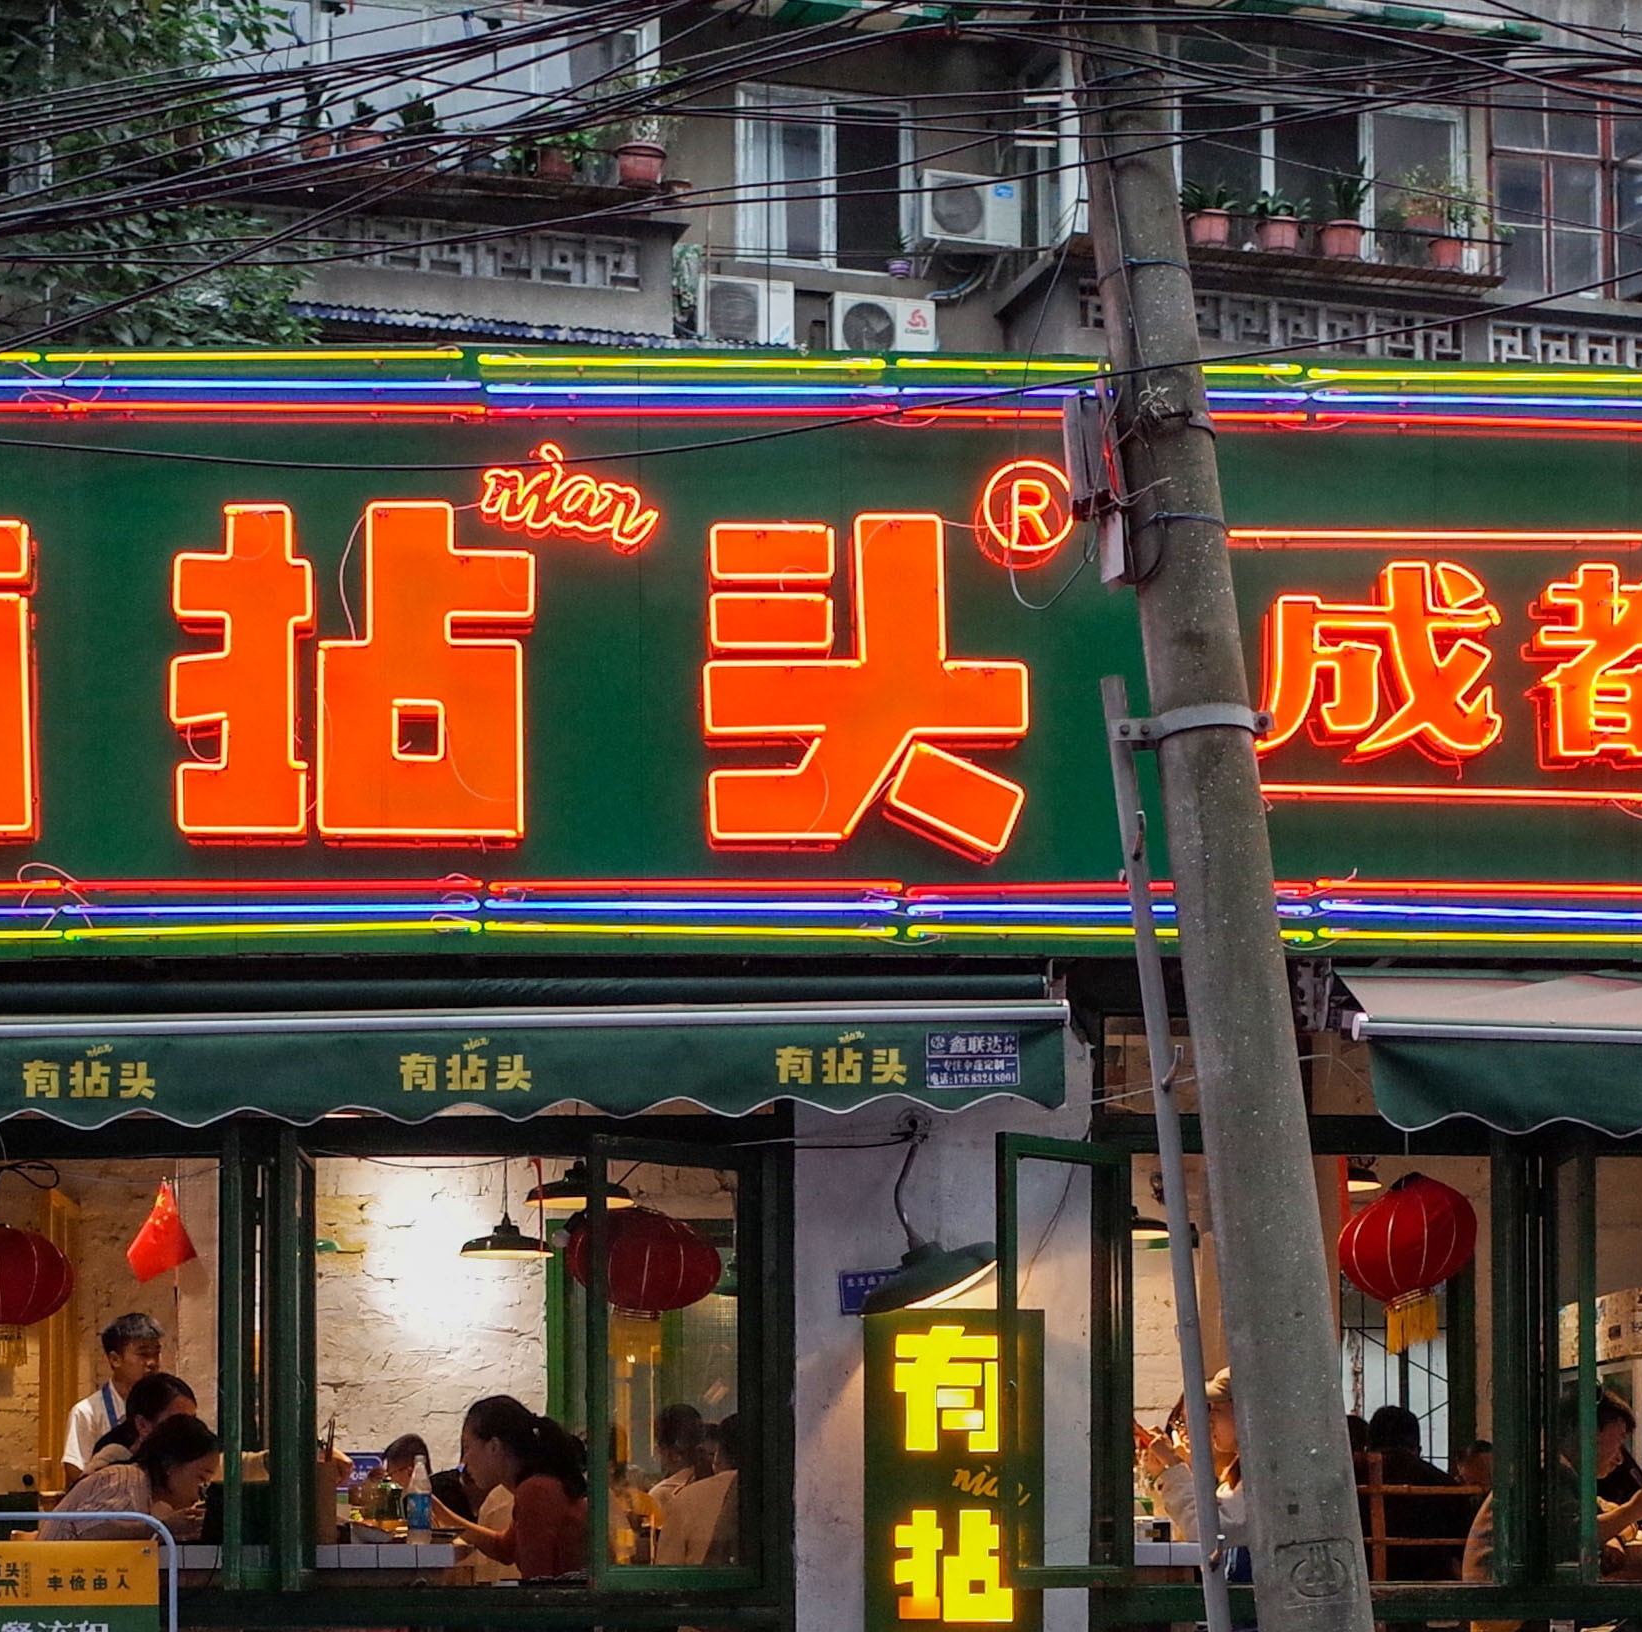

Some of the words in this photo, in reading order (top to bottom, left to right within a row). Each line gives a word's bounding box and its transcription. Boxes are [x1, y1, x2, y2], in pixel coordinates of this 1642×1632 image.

[22, 1060, 155, 1098] 有拈头
[400, 1053, 531, 1091] 有拈头
[776, 1047, 907, 1084] 有拈头
[47, 1575, 130, 1592] 丰俭由人
